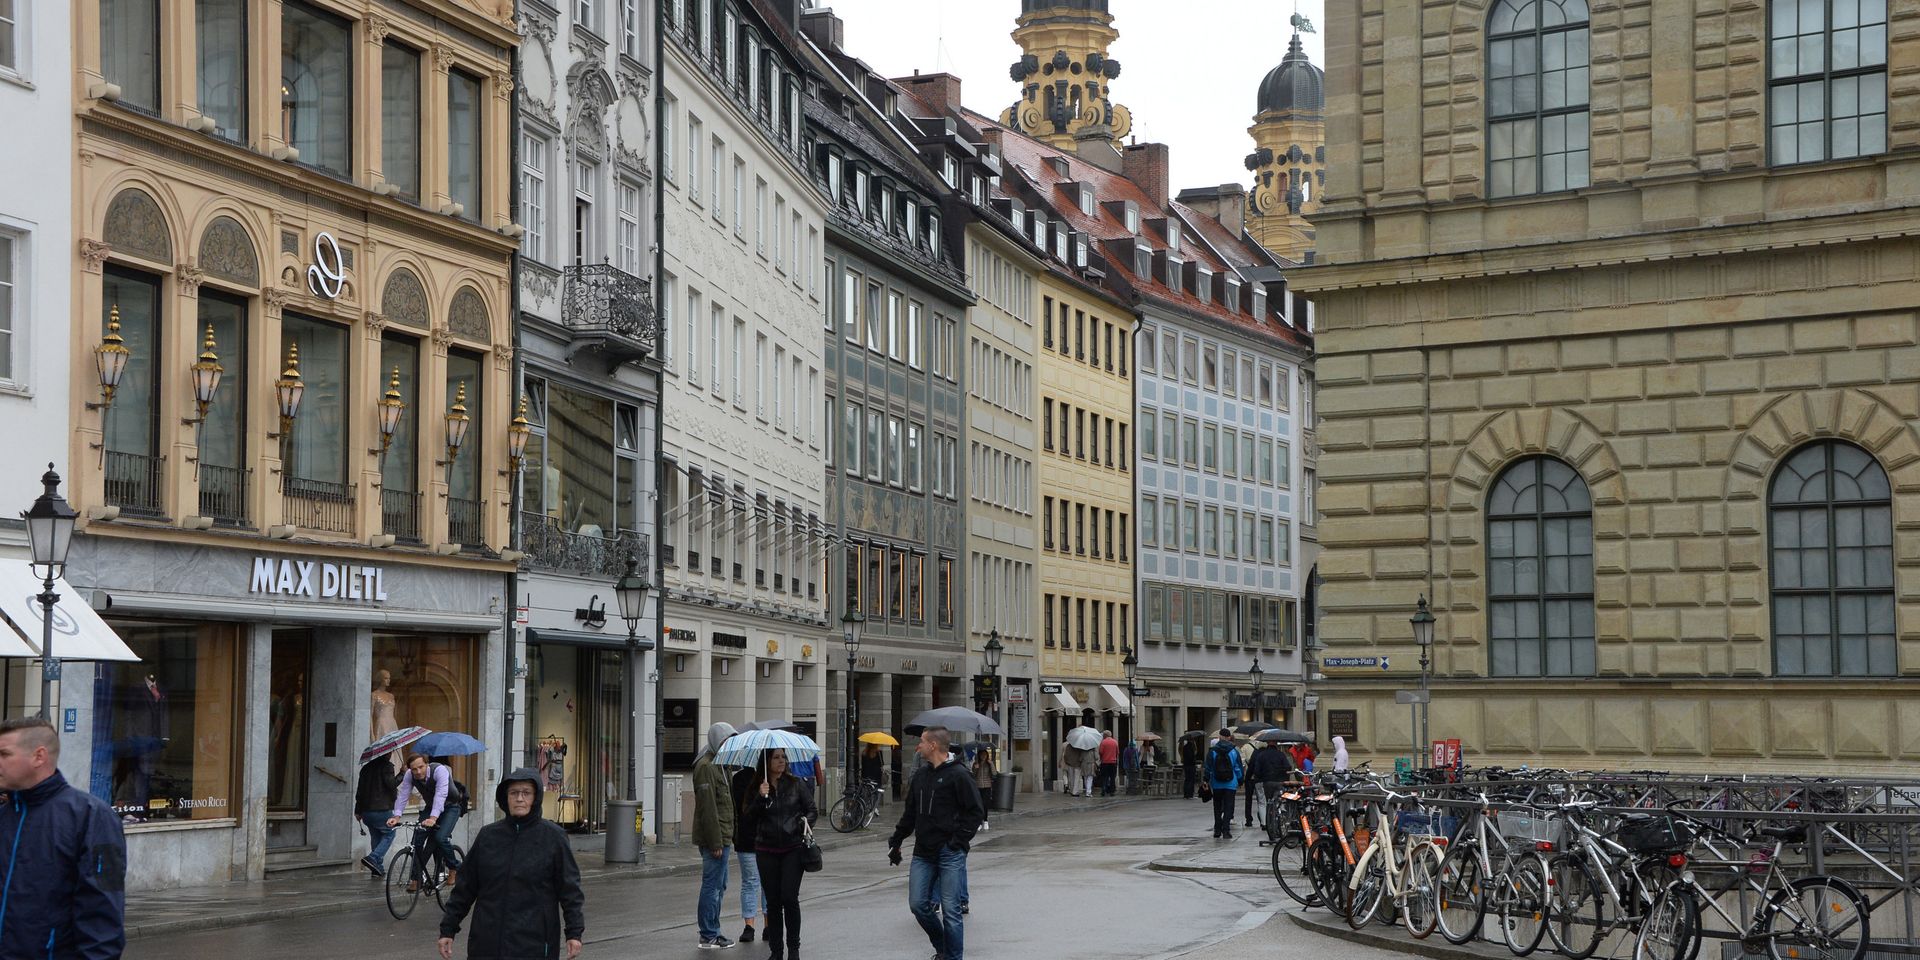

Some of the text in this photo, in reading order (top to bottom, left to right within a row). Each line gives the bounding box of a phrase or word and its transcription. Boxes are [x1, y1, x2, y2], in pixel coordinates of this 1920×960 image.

[250, 556, 387, 601] MAX DIETL
[1326, 656, 1375, 667] Max-Joseph-Platz
[67, 710, 75, 721] 16
[179, 797, 208, 809] STEFANO
[208, 796, 227, 807] RICCI
